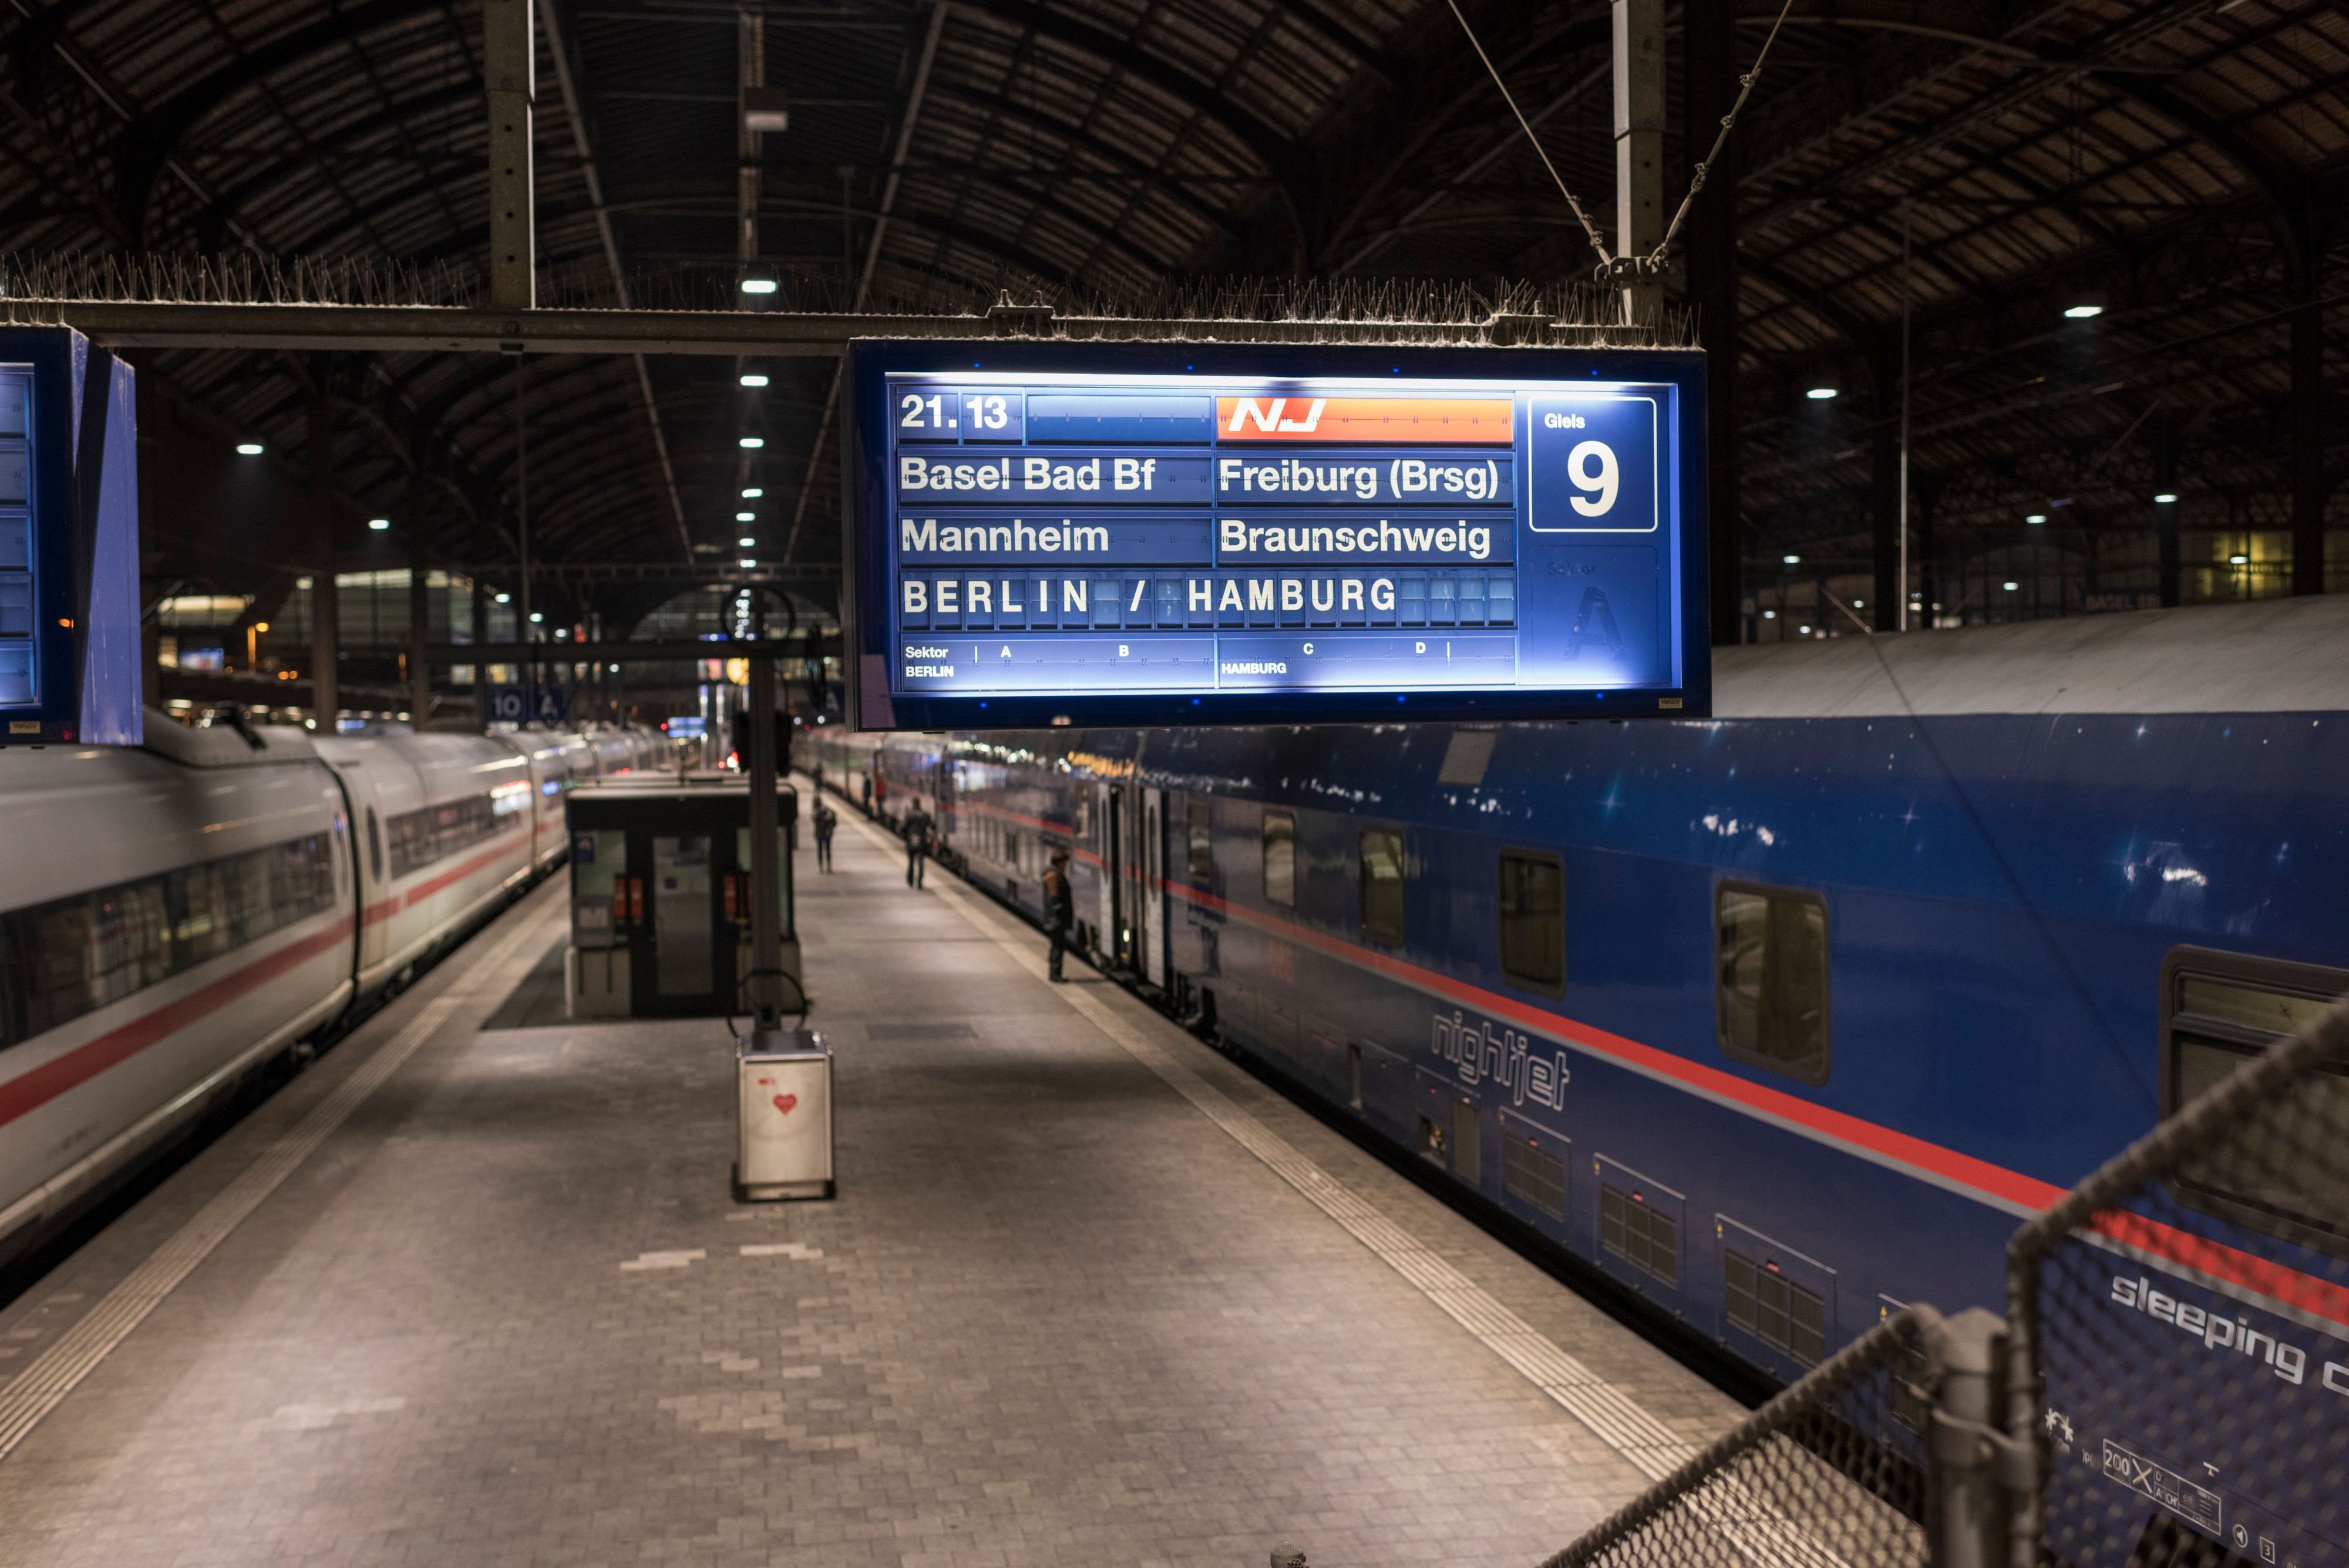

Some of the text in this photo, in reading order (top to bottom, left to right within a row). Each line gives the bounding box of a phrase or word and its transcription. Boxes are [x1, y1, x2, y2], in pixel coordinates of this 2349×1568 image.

[1228, 398, 1327, 432] NJ
[1544, 413, 1586, 429] Gleis
[901, 457, 1156, 491] Basel Bad Bf
[1220, 459, 1498, 499] Freiburg (Brsg)
[1567, 440, 1619, 517] 9
[902, 519, 1109, 551] Mannheim
[1221, 520, 1490, 560] Braunschweig
[904, 580, 1087, 613] BERLIN
[1189, 578, 1395, 611] HAMBURG
[905, 642, 1426, 658] Sektor A B C D
[906, 665, 954, 677] BERLIN
[1221, 662, 1287, 675] HAMBURG
[1432, 1010, 1570, 1112] nightjet
[2111, 1276, 2306, 1385] sleeping
[2104, 1448, 2131, 1476] 200
